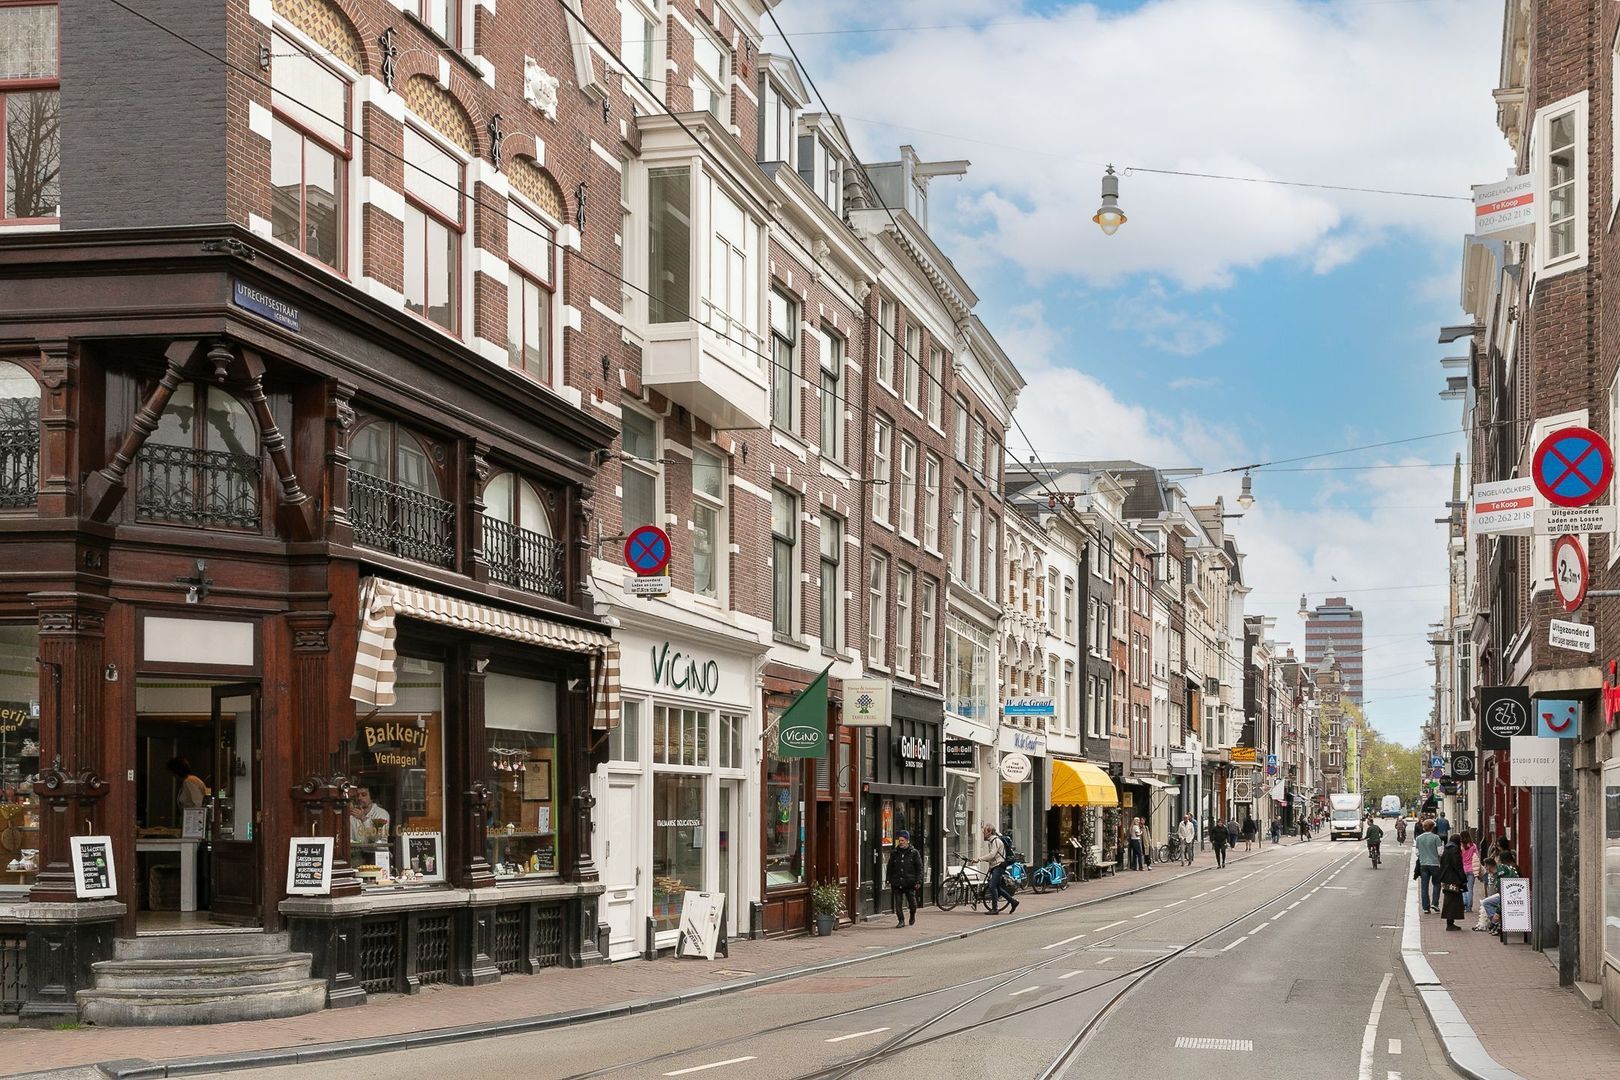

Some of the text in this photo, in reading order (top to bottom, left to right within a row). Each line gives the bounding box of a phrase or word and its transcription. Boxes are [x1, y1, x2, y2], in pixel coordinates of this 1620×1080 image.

[1501, 200, 1518, 208] Koop
[237, 283, 298, 319] UTRECHTSESTRAAT
[1479, 514, 1512, 525] 020-262
[1552, 508, 1599, 517] Uitgezonderd
[1557, 524, 1570, 532] 07.00
[1580, 523, 1593, 531] 12.00
[1552, 623, 1589, 637] Uitgezonderd
[0, 708, 27, 726] erij
[365, 722, 429, 752] Bakkerij
[375, 752, 417, 767] Verhagen
